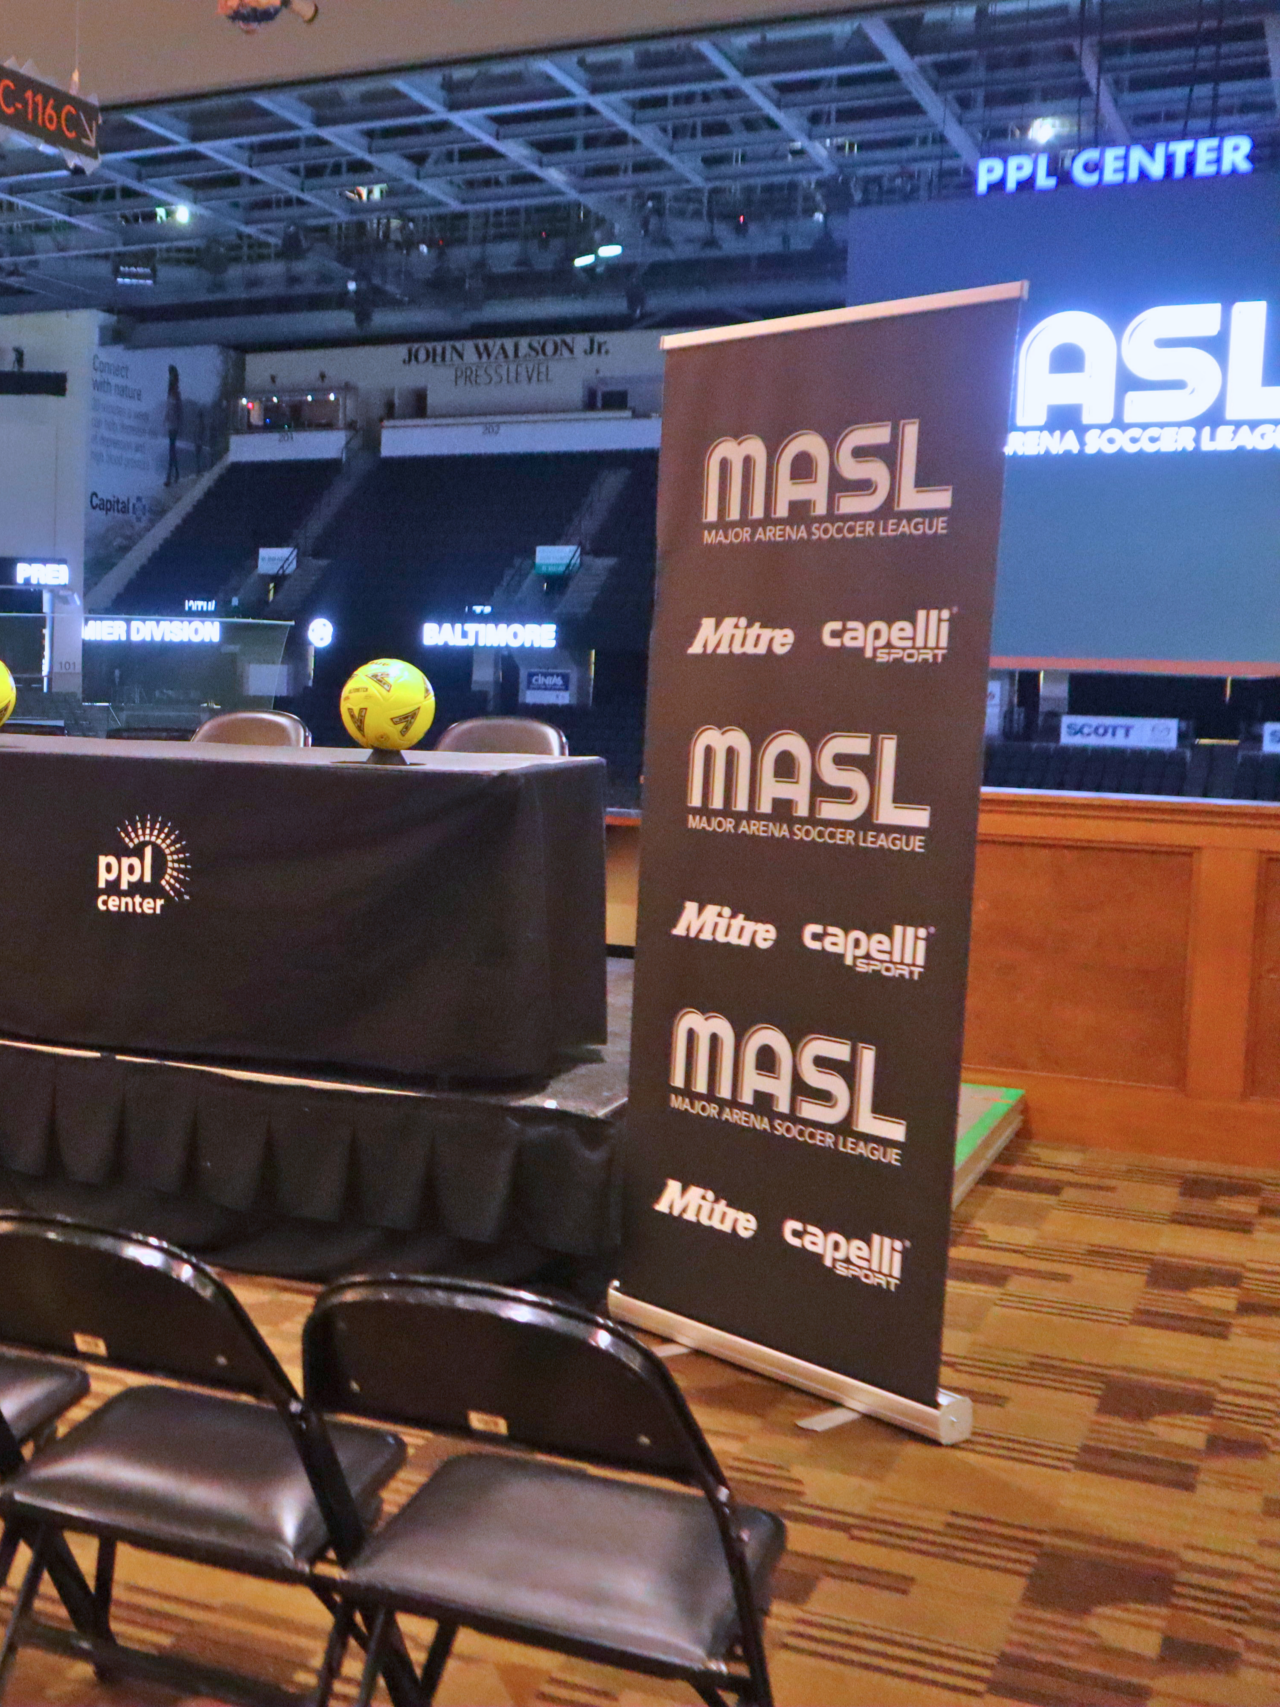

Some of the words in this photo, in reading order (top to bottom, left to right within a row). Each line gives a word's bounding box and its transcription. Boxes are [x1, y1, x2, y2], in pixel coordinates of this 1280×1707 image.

[976, 152, 1057, 195] PPL
[1072, 135, 1254, 188] CENTER
[402, 343, 465, 365] JOHN
[473, 337, 576, 361] WALSON
[584, 335, 610, 357] Jr.
[1084, 427, 1196, 454] SOCCER
[702, 419, 953, 523] MASL
[90, 491, 130, 516] Capital
[703, 526, 751, 545] MAJOR
[754, 524, 808, 543] ARENA
[811, 521, 875, 540] SOCCER
[879, 516, 949, 537] LEAGUE
[130, 620, 220, 642] DIVISION
[422, 622, 557, 648] BALTIMORE
[687, 616, 795, 655] Mitre
[822, 608, 951, 658] capelli
[58, 661, 77, 671] 101
[875, 648, 948, 663] SPORT
[1065, 722, 1135, 739] SCOTT
[687, 724, 931, 828] MASL
[687, 814, 735, 833] MAJOR
[738, 819, 790, 839] ARENA
[793, 824, 856, 846] SOCCER
[858, 831, 926, 852] LEAGUE
[98, 844, 152, 890] ppl
[97, 894, 165, 914] center
[671, 900, 778, 950] Mitre
[802, 923, 928, 966] capelli
[855, 958, 925, 980] SPORT
[669, 1007, 907, 1142] MASL
[670, 1093, 719, 1119] MAJOR
[722, 1107, 770, 1133] ARENA
[773, 1119, 835, 1149] SOCCER
[838, 1136, 902, 1167] LEAGUE
[652, 1178, 758, 1239] Mitre
[782, 1218, 903, 1278] capelli
[833, 1260, 901, 1292] SPORT
